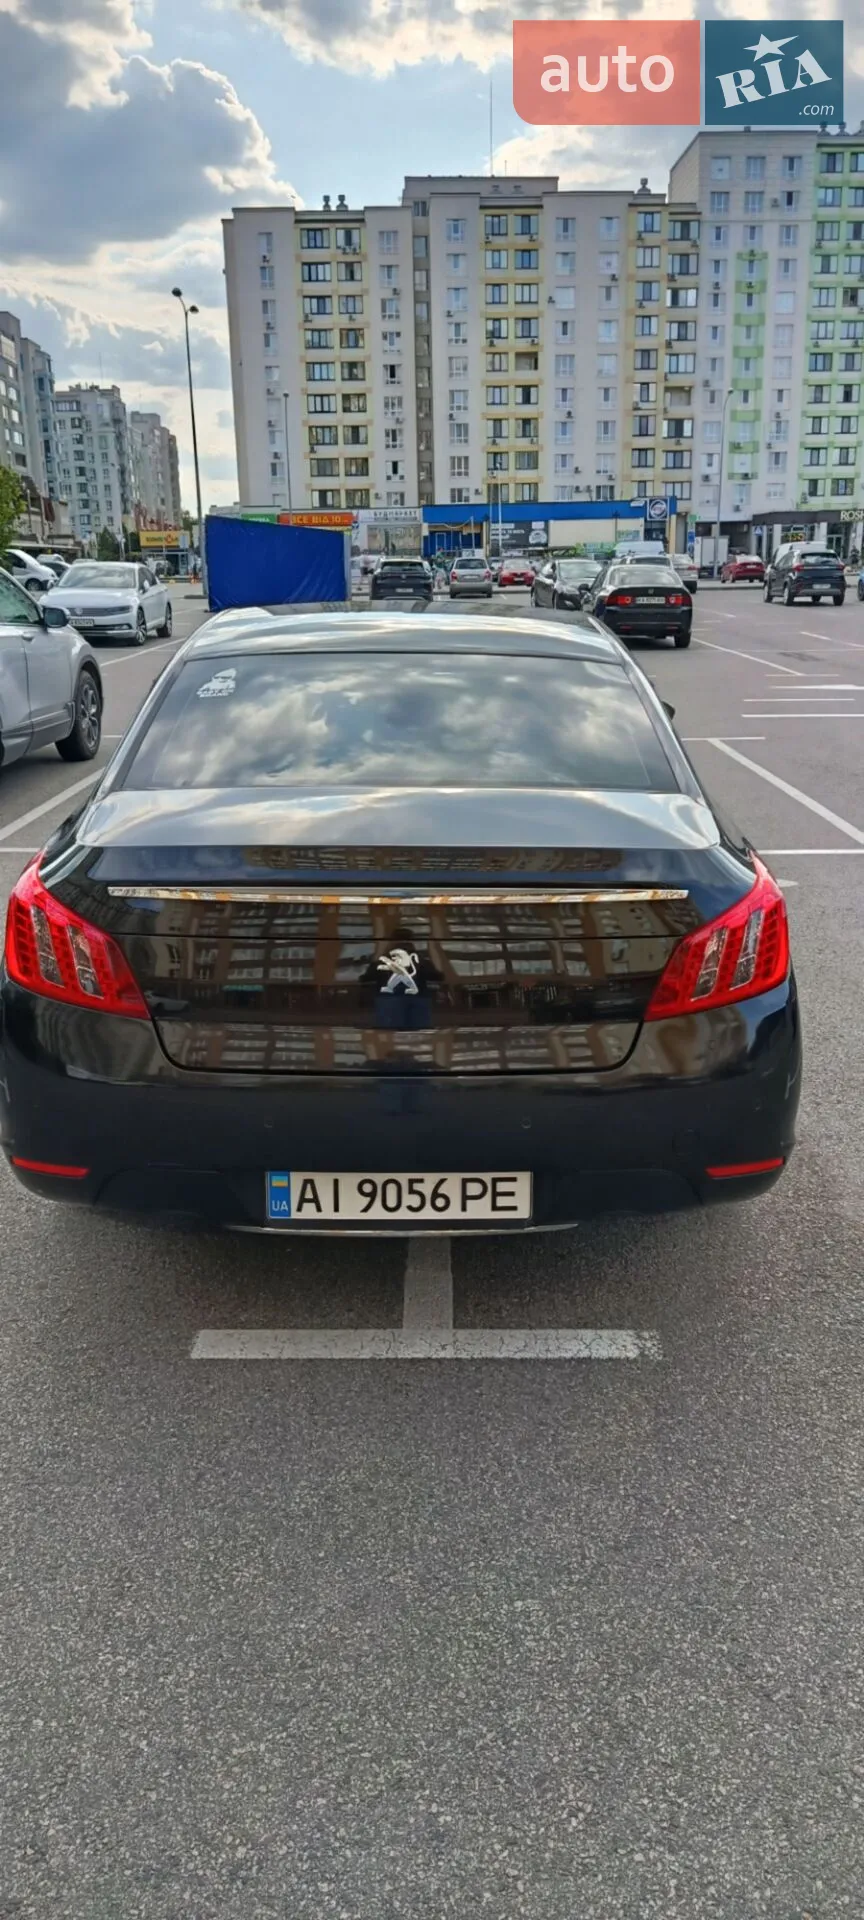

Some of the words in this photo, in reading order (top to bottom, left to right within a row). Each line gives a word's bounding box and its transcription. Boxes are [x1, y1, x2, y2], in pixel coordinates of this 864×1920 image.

[272, 1200, 289, 1212] UA
[296, 1178, 340, 1213] AI
[356, 1178, 451, 1213] 9056
[461, 1177, 518, 1212] PE
